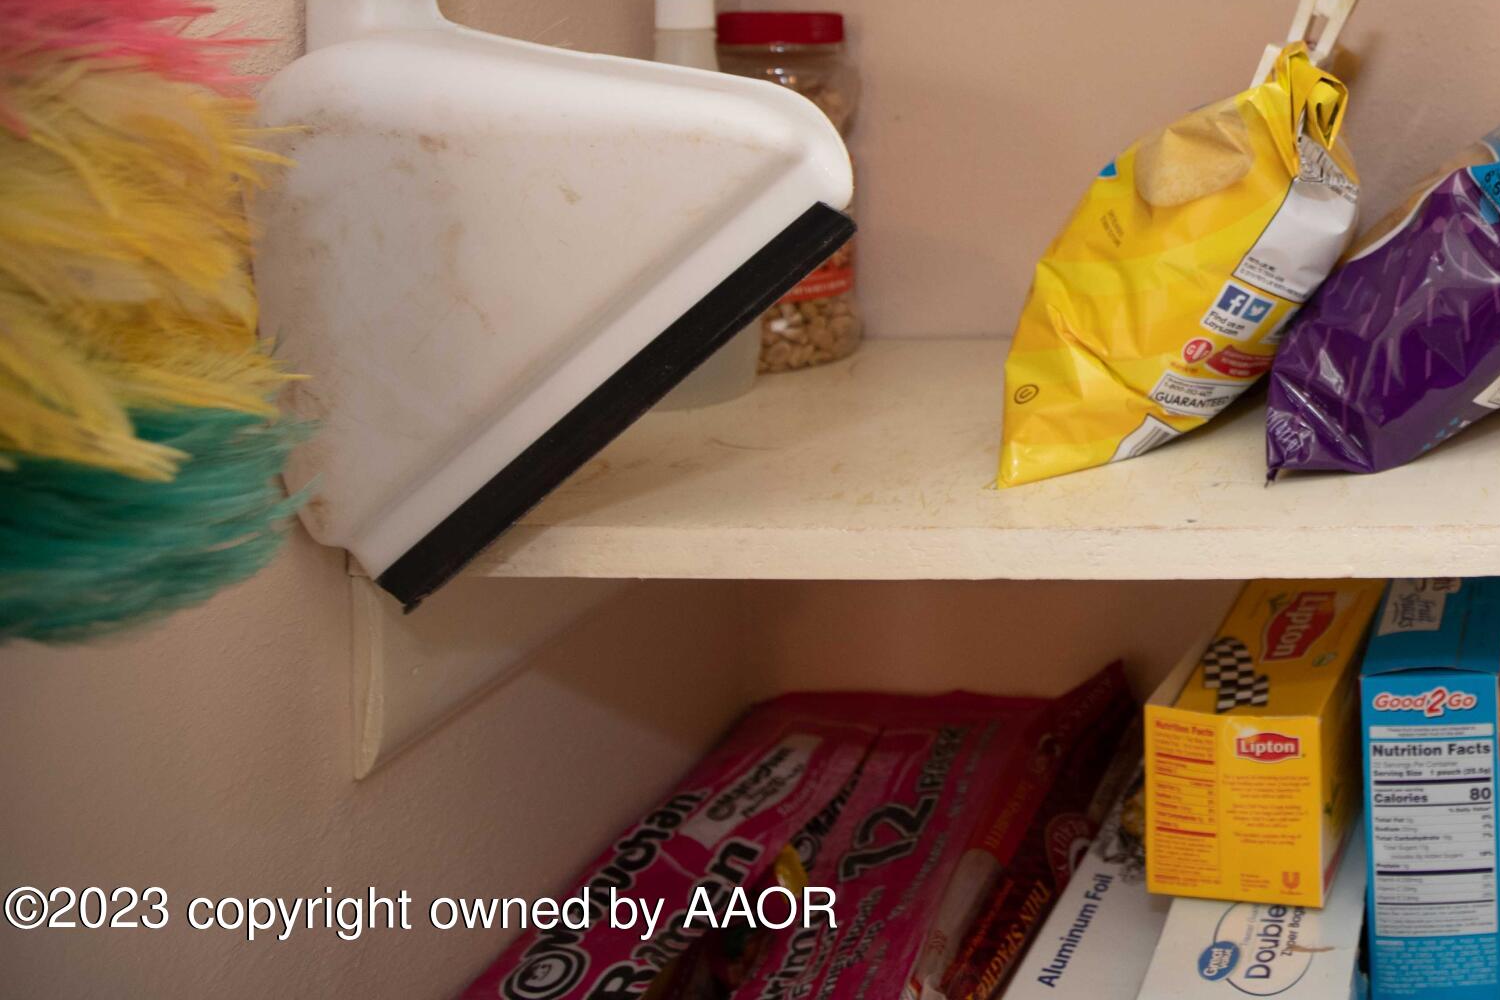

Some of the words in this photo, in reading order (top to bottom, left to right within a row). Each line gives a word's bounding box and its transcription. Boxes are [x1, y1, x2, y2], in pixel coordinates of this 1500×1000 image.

[1274, 595, 1330, 657] Lipton
[1373, 687, 1478, 717] Good2Go
[1239, 737, 1297, 755] Lipton
[1372, 743, 1442, 758] Nutrition
[1447, 742, 1491, 755] Facts
[1374, 793, 1428, 804] Calories
[1469, 787, 1492, 800] 80
[841, 797, 937, 881] 12
[524, 790, 704, 957] Maruchan
[1037, 898, 1099, 988] Aluminum
[1089, 873, 1114, 903] Foil
[1244, 905, 1288, 980] Double
